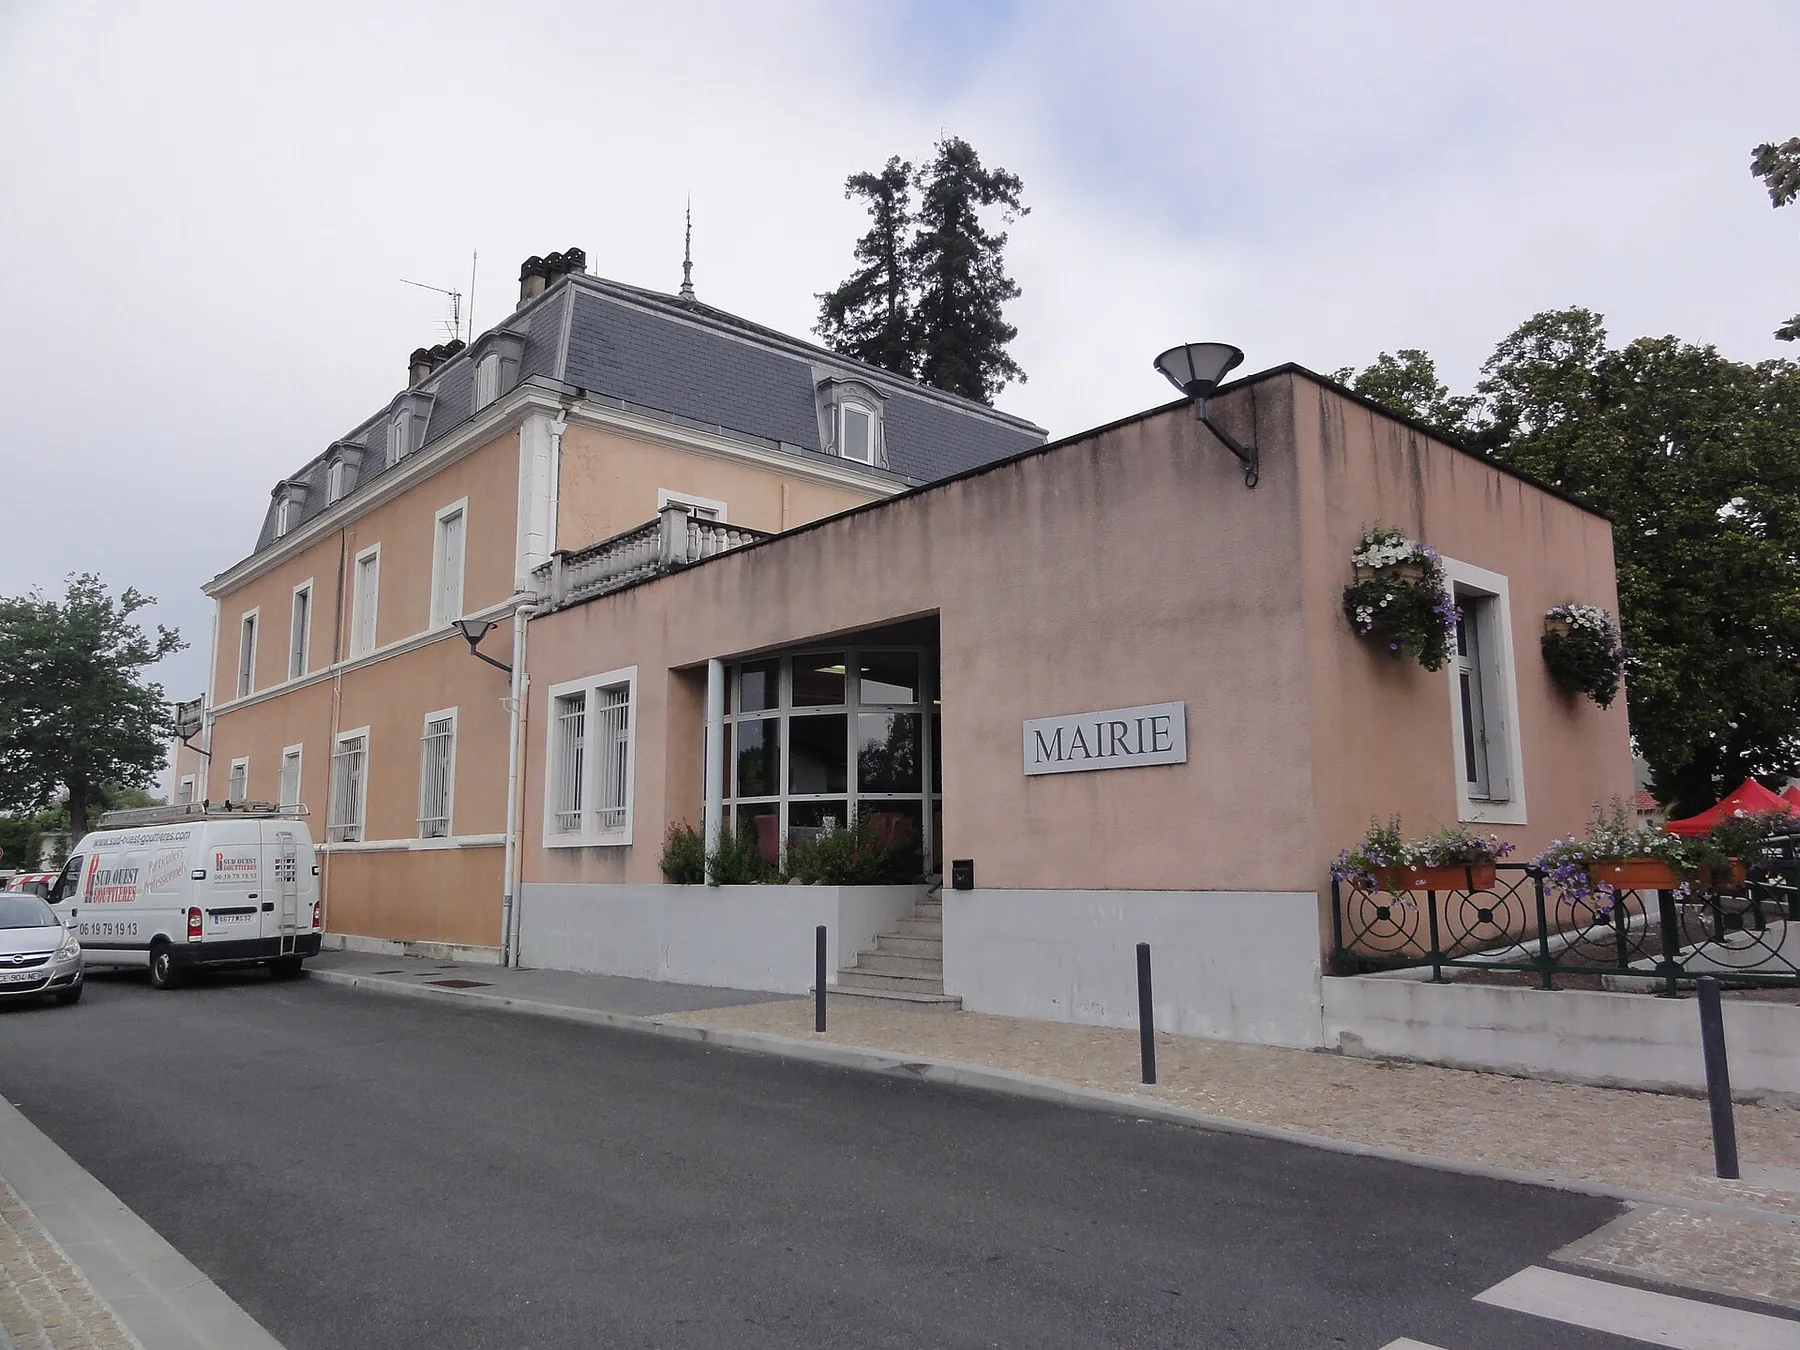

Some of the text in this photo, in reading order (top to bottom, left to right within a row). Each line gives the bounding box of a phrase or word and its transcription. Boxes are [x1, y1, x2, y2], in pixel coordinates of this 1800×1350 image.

[1033, 715, 1174, 764] MAIRIE
[95, 868, 140, 886] SUD OUEST
[93, 886, 137, 904] GOUTTIERES
[80, 922, 138, 935] 06 19 79 19 13
